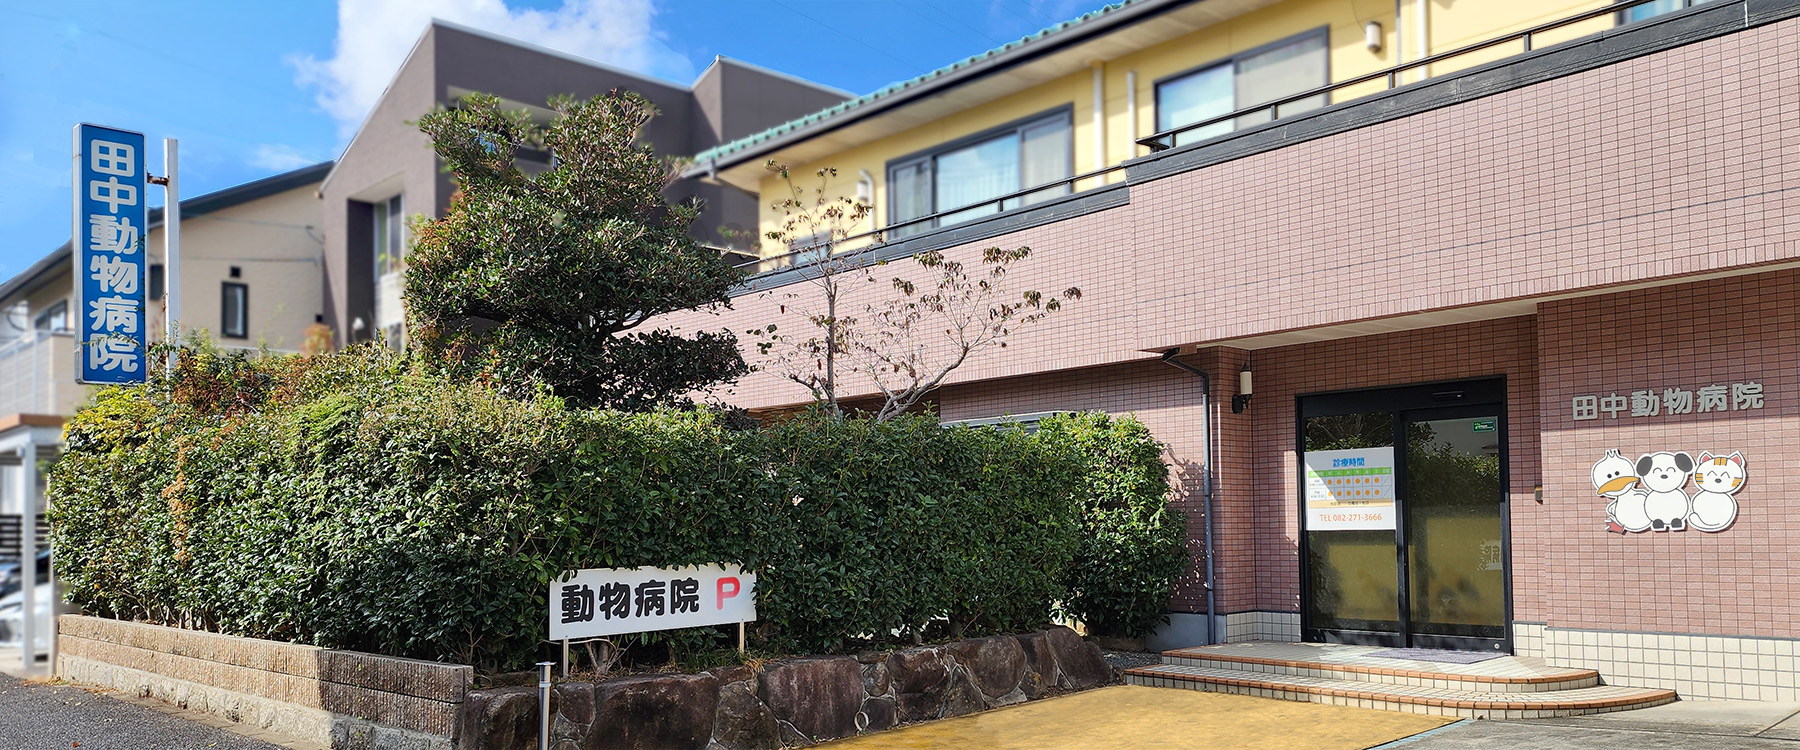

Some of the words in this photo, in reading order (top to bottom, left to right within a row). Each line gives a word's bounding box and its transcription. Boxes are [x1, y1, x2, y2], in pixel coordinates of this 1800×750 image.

[89, 138, 139, 373] 田中動物病院
[1572, 381, 1765, 421] 田中動物病院
[1332, 457, 1365, 468] 診療時間
[1320, 514, 1332, 522] TEL
[1332, 513, 1383, 522] 082-271-3666
[561, 577, 700, 624] 動物病院
[716, 576, 741, 611] P
